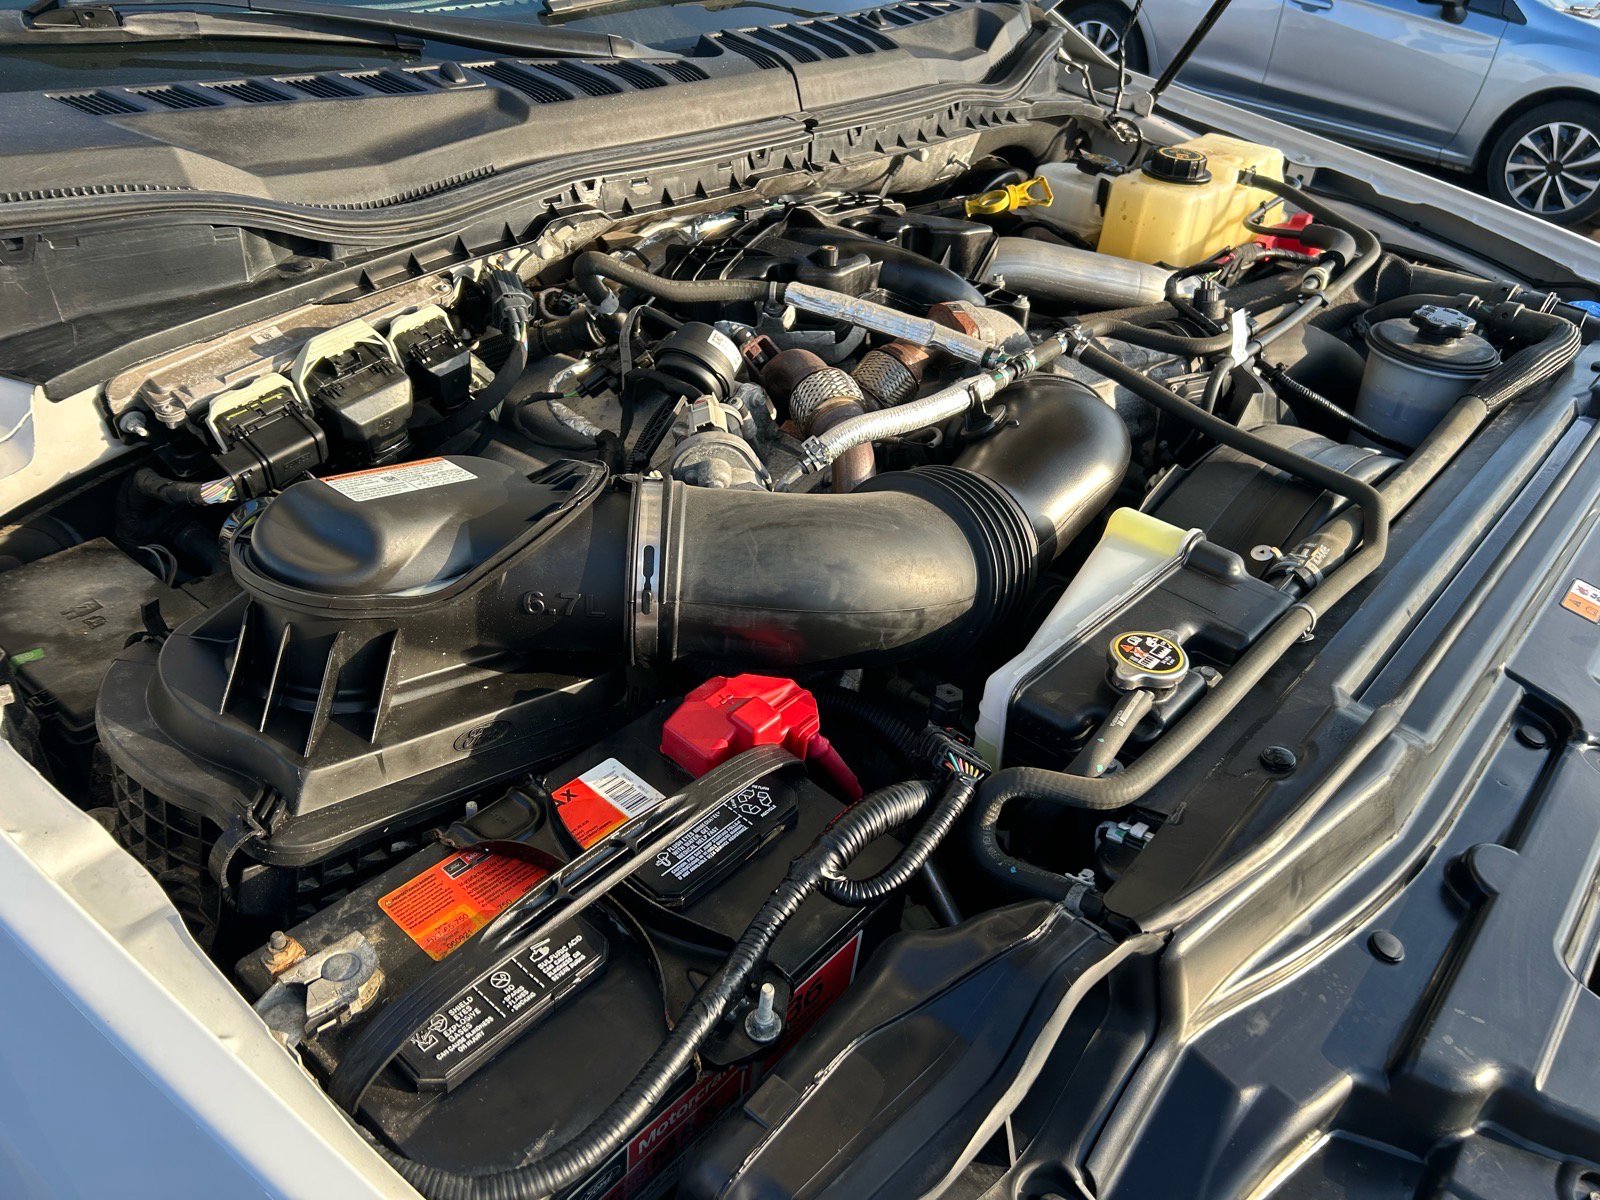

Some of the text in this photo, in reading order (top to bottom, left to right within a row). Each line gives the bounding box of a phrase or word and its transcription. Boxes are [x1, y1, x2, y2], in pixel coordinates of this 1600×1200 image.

[522, 590, 605, 617] 6.7L
[700, 826, 710, 835] GET
[537, 935, 582, 970] SULFURIC ACID
[503, 984, 515, 994] NO
[448, 996, 473, 1016] SHIELD
[453, 1005, 472, 1021] EYES
[442, 1007, 481, 1038] EXPLOSIVE
[448, 1022, 473, 1042] GASES
[436, 1049, 450, 1061] CAN
[448, 1036, 467, 1052] CAUSE
[638, 1066, 734, 1155] Motorcra
